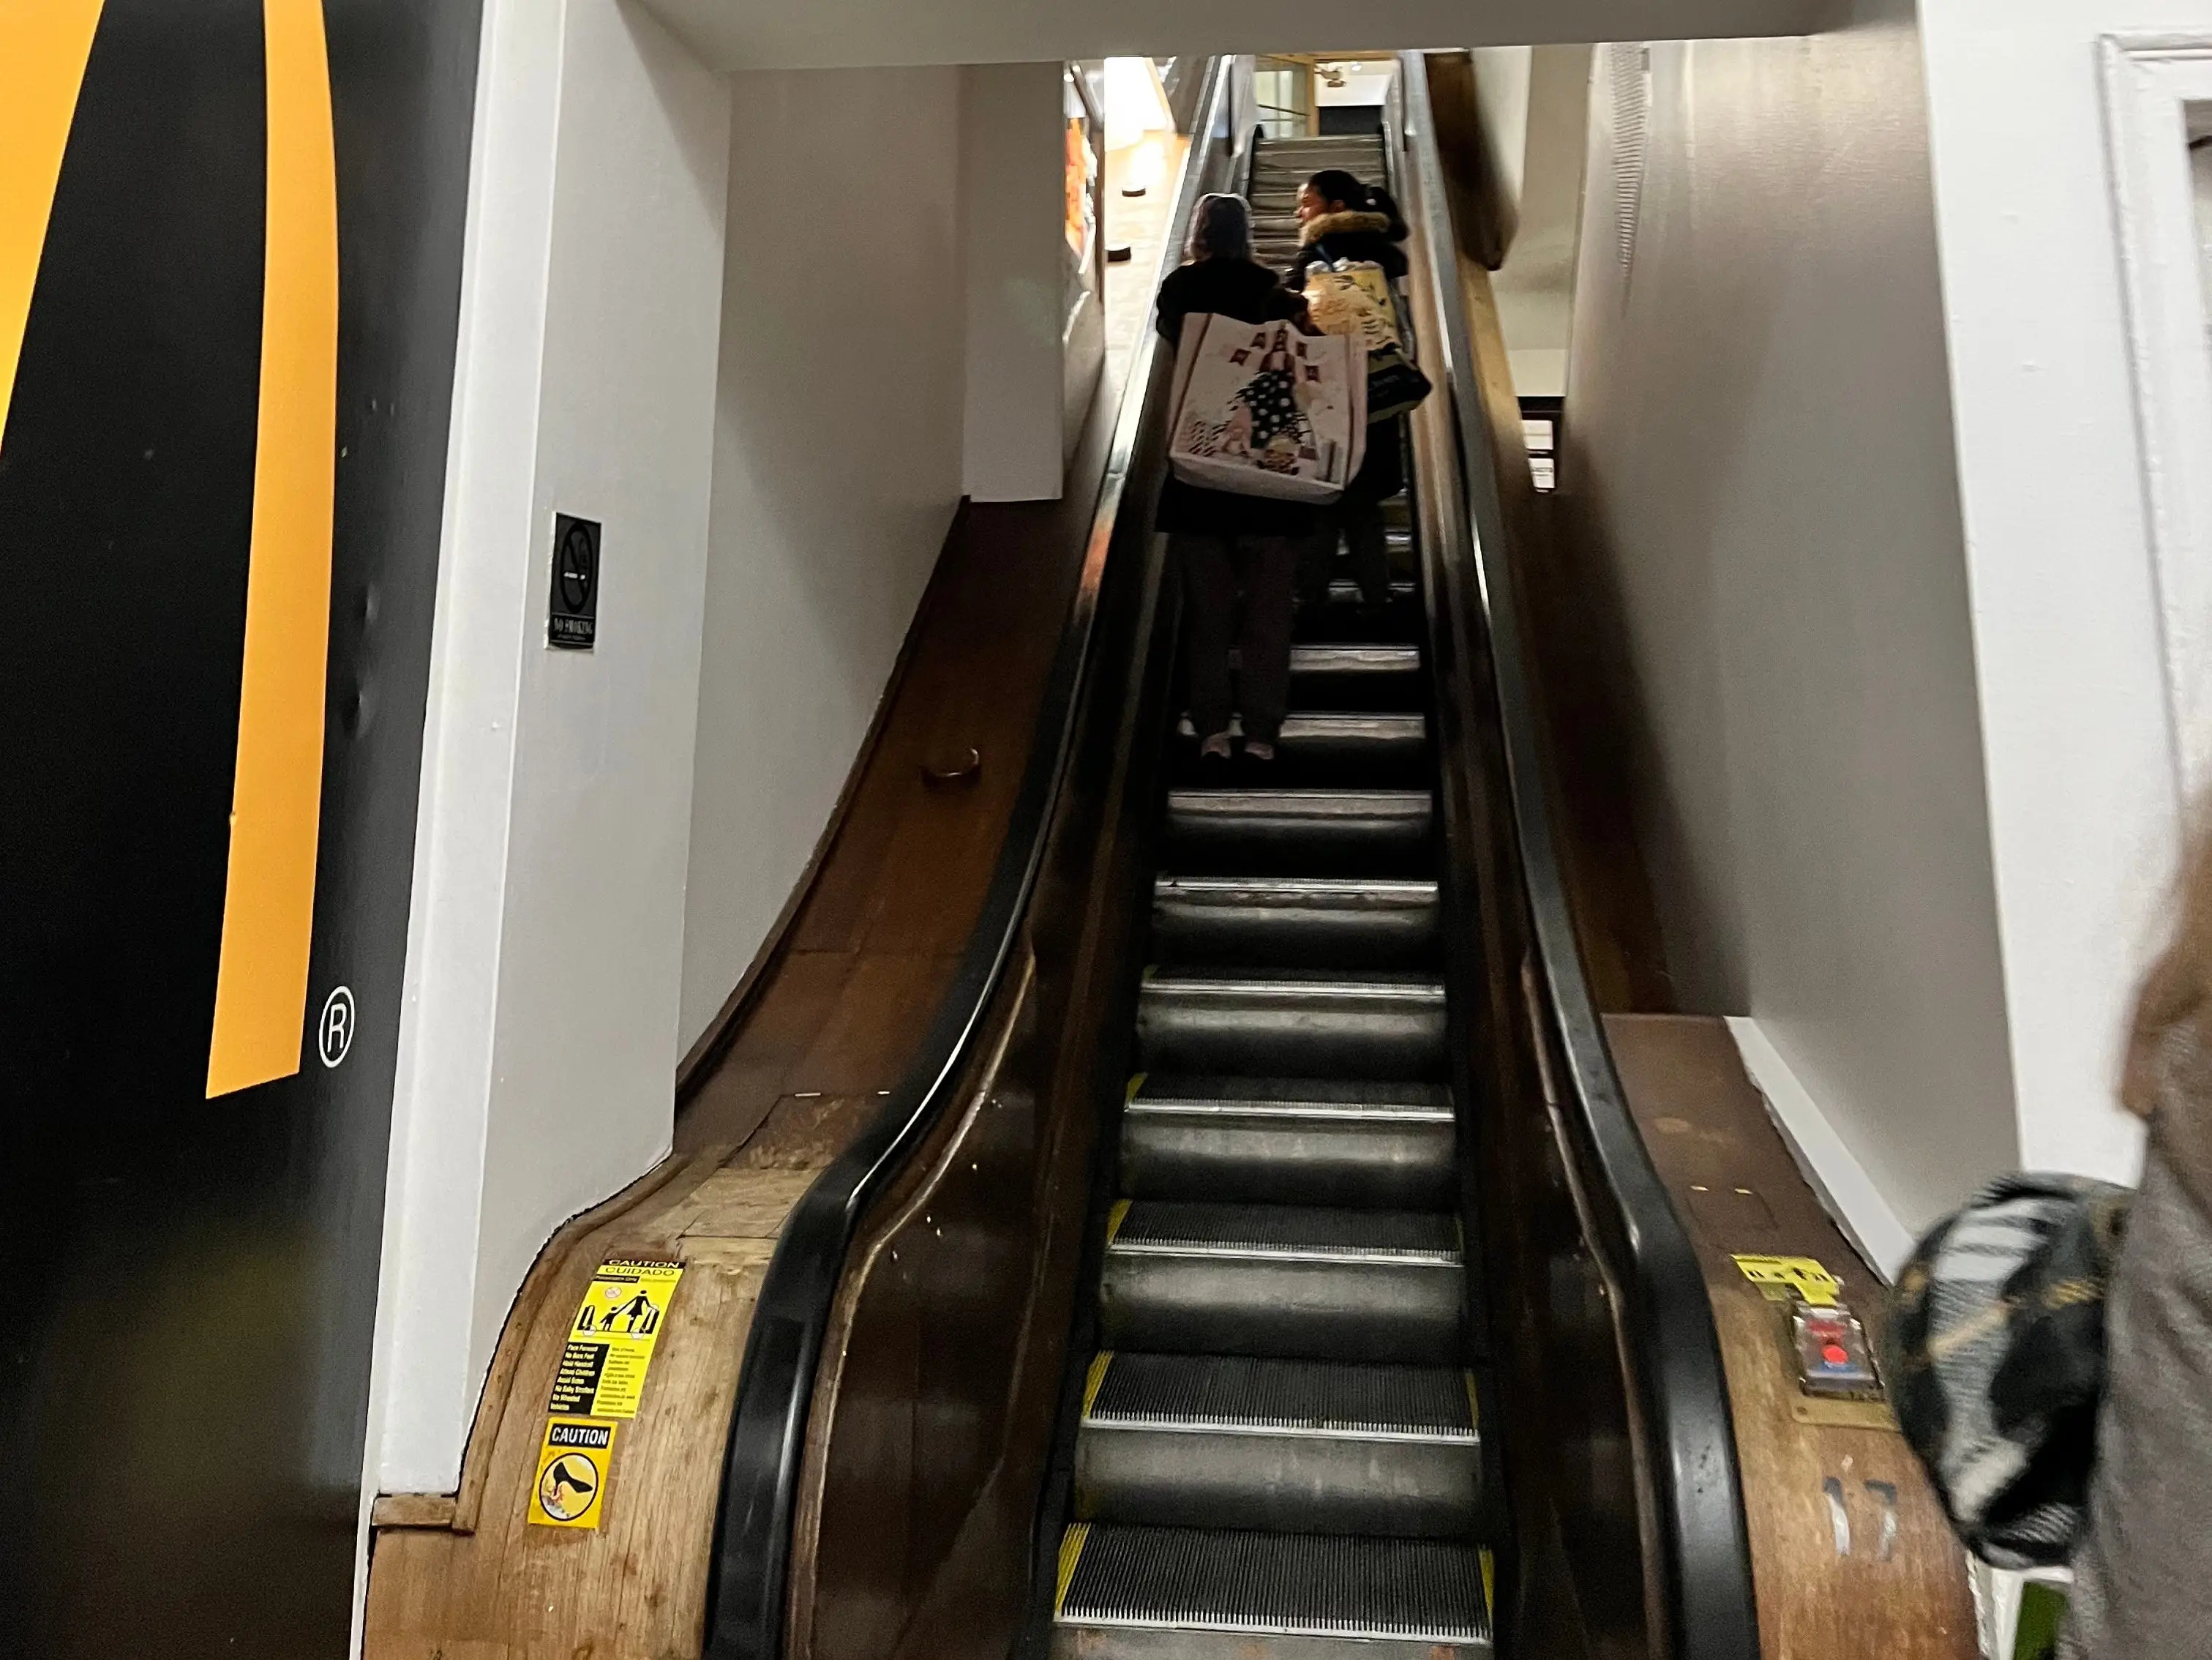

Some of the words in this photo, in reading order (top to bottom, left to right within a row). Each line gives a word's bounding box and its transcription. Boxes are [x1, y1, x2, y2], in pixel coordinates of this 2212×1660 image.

[608, 1260, 680, 1268] CAUTION
[605, 1267, 675, 1276] CUIDADO
[552, 1427, 609, 1446] CAUTION
